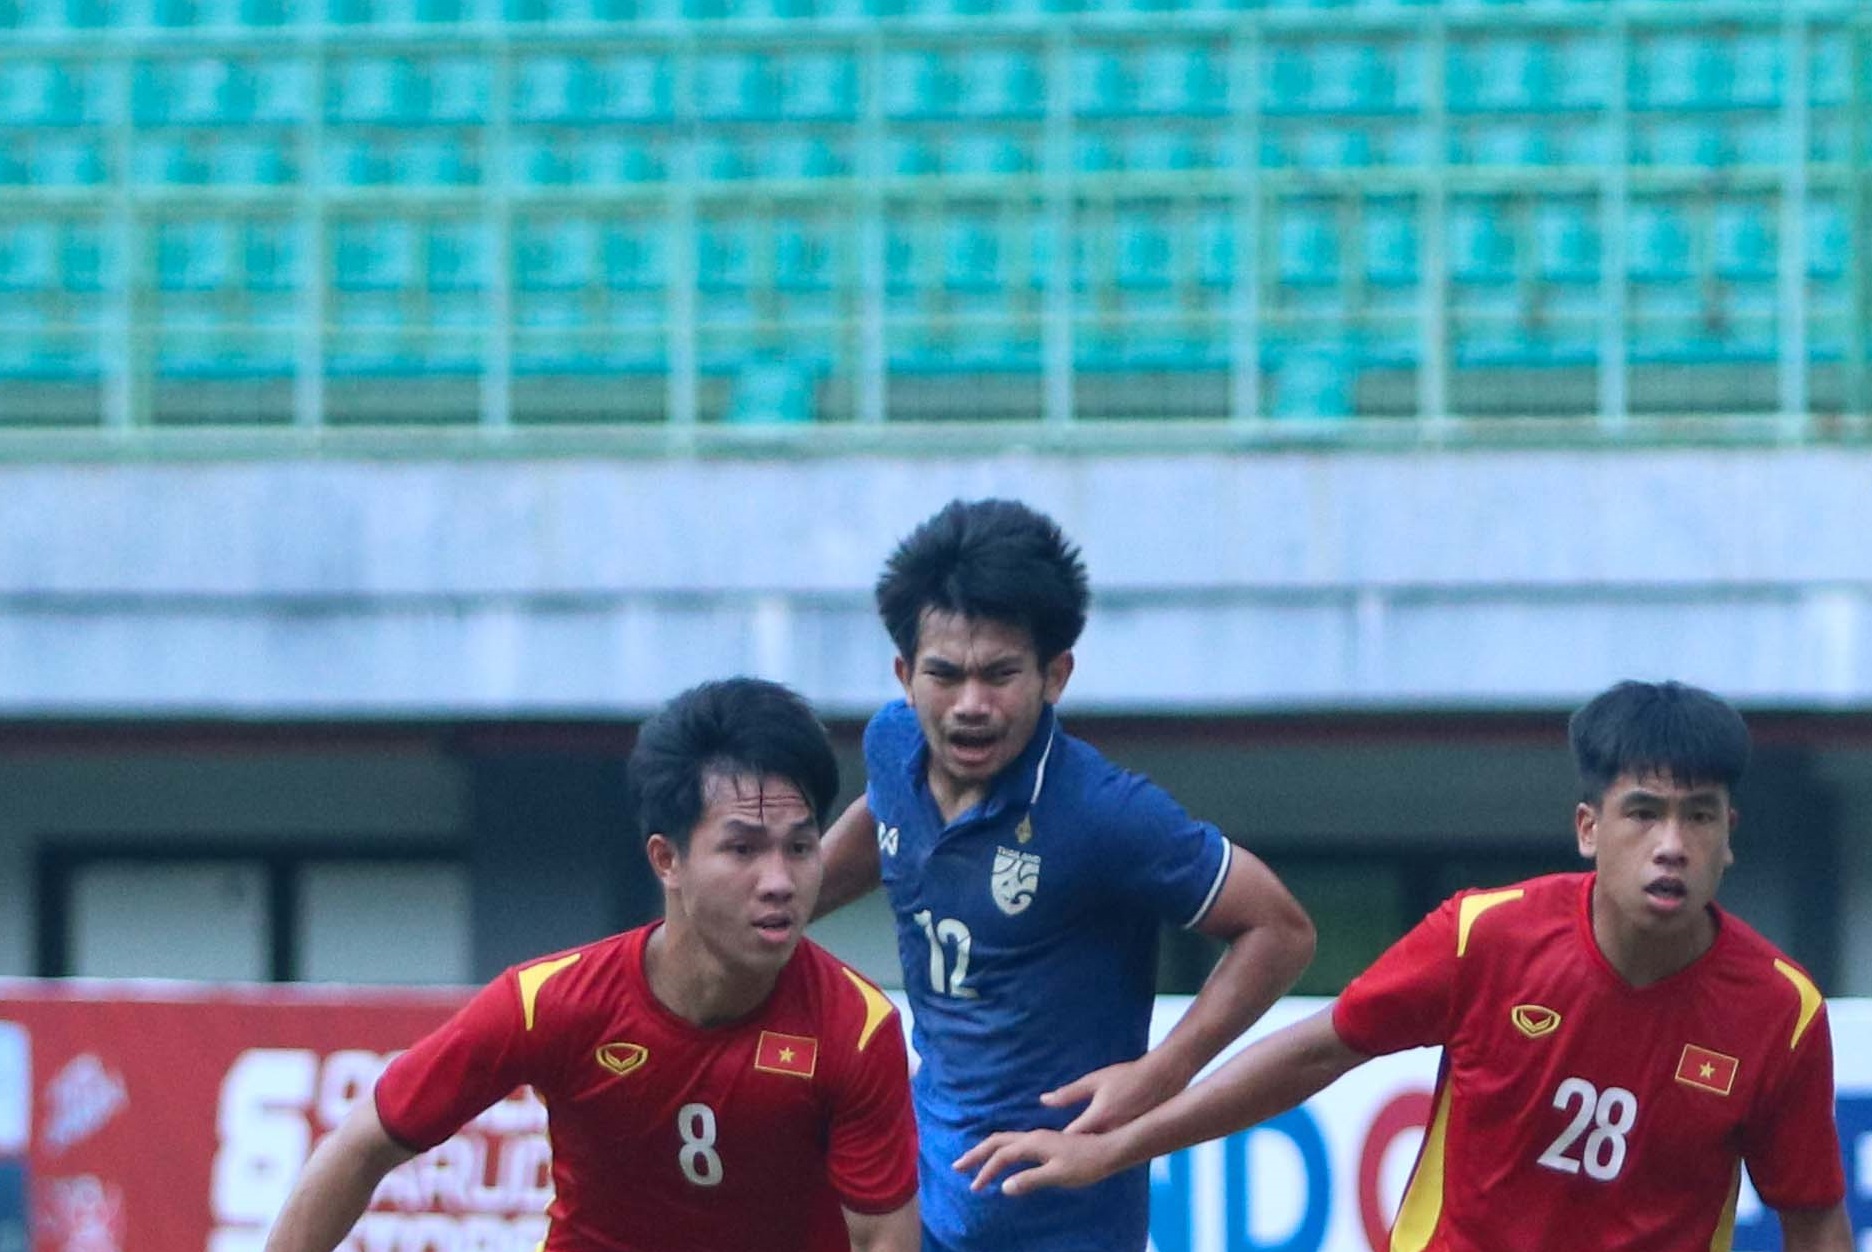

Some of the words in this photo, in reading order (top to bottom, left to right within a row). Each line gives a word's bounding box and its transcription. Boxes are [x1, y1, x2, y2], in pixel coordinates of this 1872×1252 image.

[913, 908, 979, 998] 12
[677, 1102, 724, 1187] 8
[1536, 1076, 1639, 1182] 28
